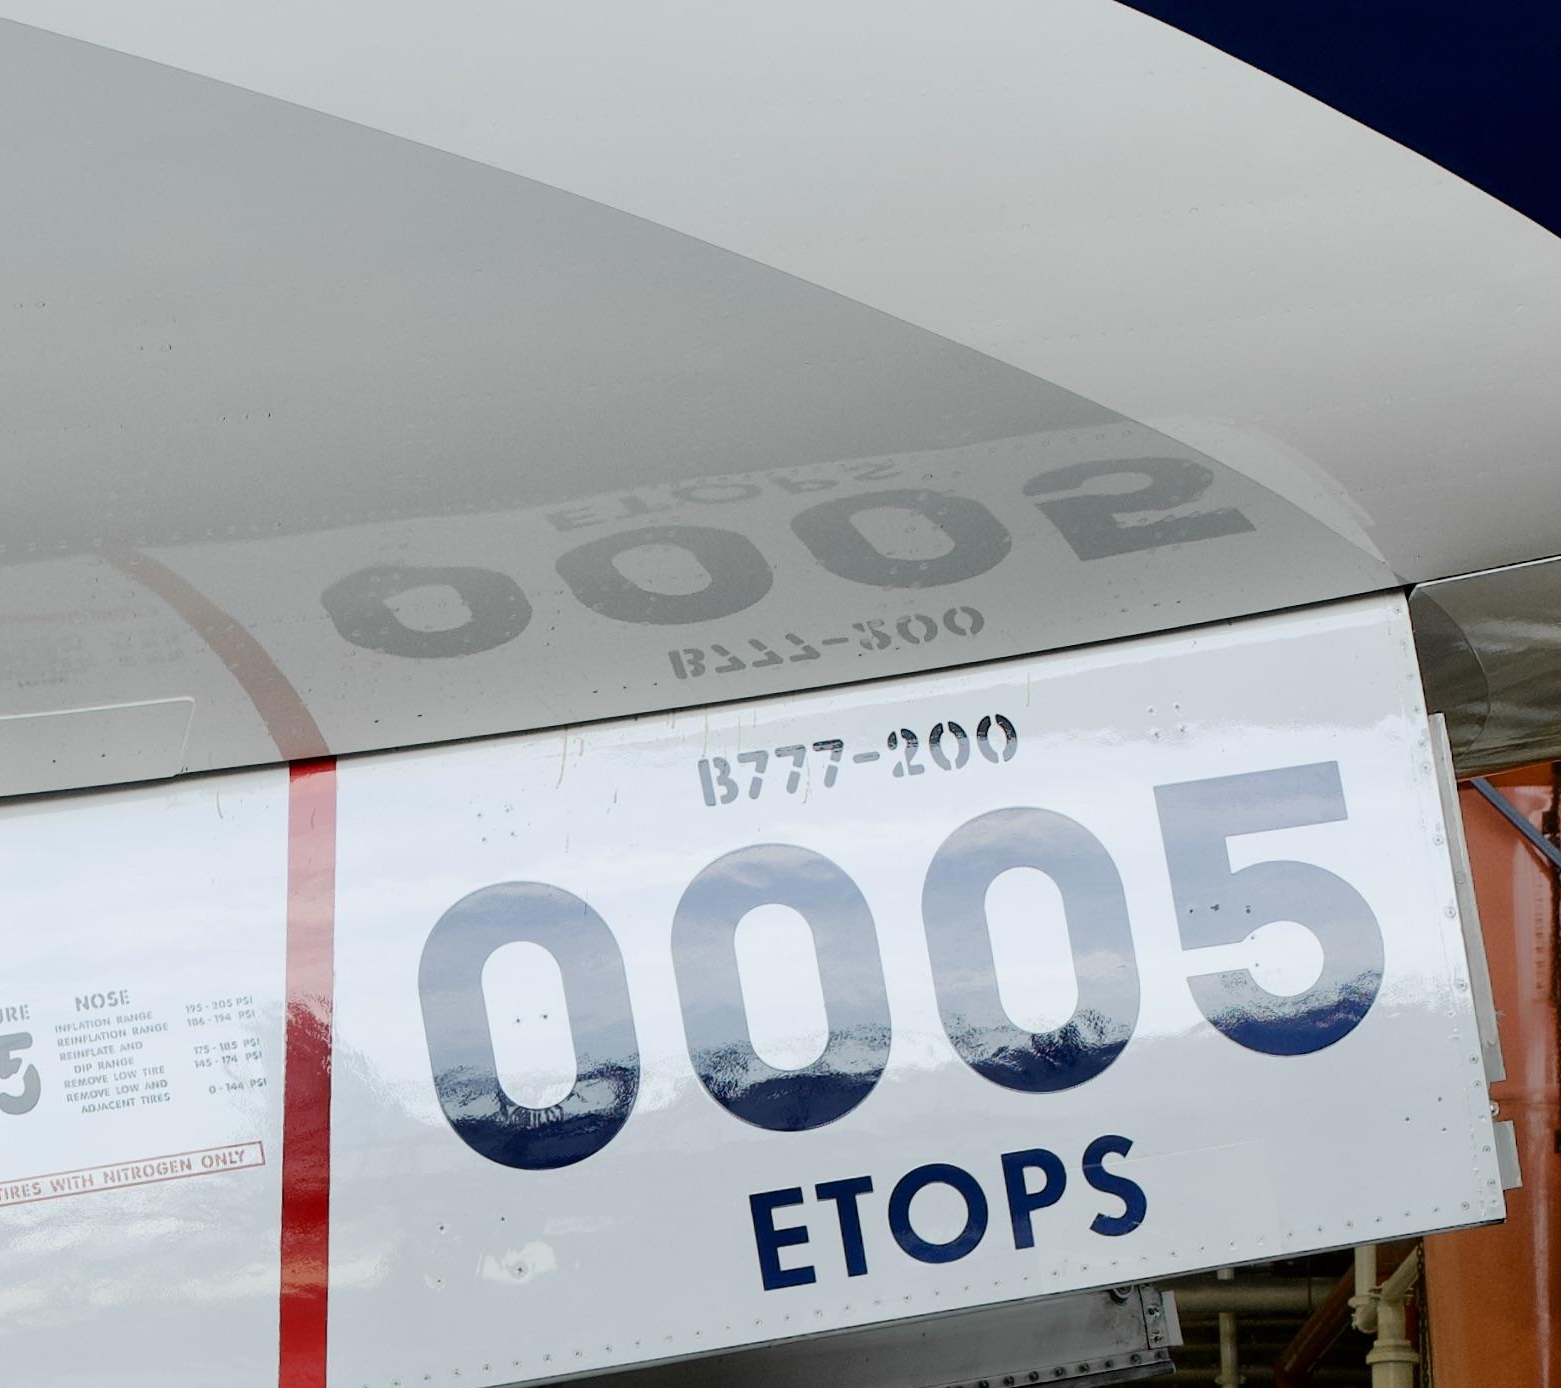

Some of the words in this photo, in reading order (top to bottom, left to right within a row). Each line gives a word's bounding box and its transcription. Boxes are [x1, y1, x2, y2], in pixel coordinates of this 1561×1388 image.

[696, 712, 1019, 807] B777-200
[417, 760, 1386, 1172] 0005
[74, 988, 131, 1013] NOSE
[185, 1003, 202, 1014] 195
[212, 997, 233, 1011] 205
[235, 995, 253, 1007] PSI
[54, 1017, 111, 1034] INFLATION
[116, 1010, 154, 1024] RANGE
[215, 1011, 233, 1023] 194
[238, 1008, 256, 1020] PSI
[57, 1030, 127, 1048] REINFLATION
[132, 1022, 169, 1036] RANGE
[193, 1044, 210, 1056] 175
[243, 1036, 261, 1048] PSI
[59, 1044, 115, 1062] REINFLATE
[119, 1040, 144, 1053] AND
[194, 1057, 213, 1069] 145
[221, 1054, 239, 1065] 174
[245, 1050, 263, 1062] PSI
[64, 1074, 109, 1090] REMOVE
[113, 1070, 138, 1082] LOW
[142, 1065, 166, 1078] TIRE
[73, 1063, 93, 1075] DIP
[97, 1056, 135, 1070] RANGE
[66, 1087, 111, 1103] REMOVE
[116, 1083, 140, 1096] LOW
[144, 1079, 169, 1091] AND
[226, 1081, 245, 1093] 144
[250, 1076, 268, 1089] PSI
[80, 1097, 136, 1115] ADJACENT
[140, 1092, 172, 1106] TIRES
[49, 1171, 95, 1193] WITH
[102, 1156, 192, 1184] NITROGEN
[200, 1148, 246, 1169] ONLY
[749, 1133, 1149, 1292] ETOPS
